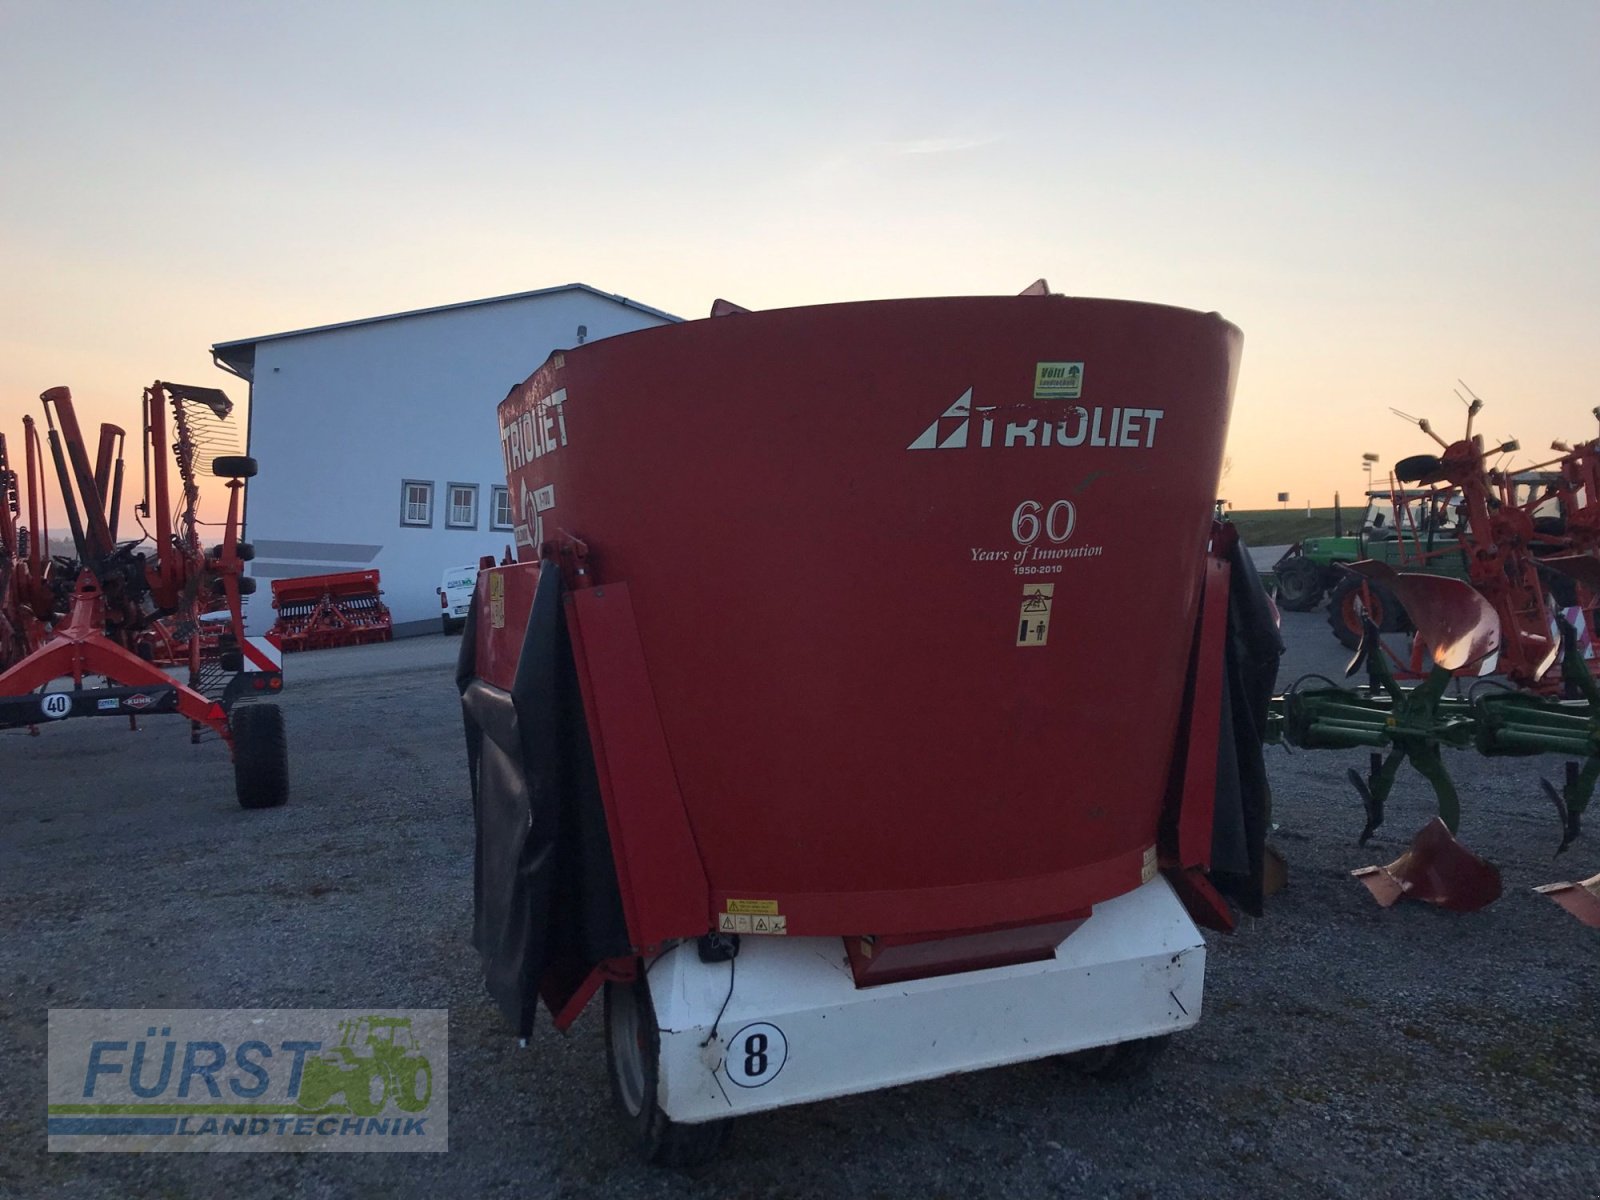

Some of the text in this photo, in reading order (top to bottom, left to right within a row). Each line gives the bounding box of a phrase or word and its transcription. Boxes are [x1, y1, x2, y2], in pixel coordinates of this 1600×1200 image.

[502, 387, 568, 474] TRIOLIET
[1011, 500, 1076, 545] 60
[970, 543, 1103, 566] Years of Innovation
[1013, 565, 1062, 575] 1950-2010
[47, 696, 66, 713] 40
[744, 1033, 768, 1077] 8
